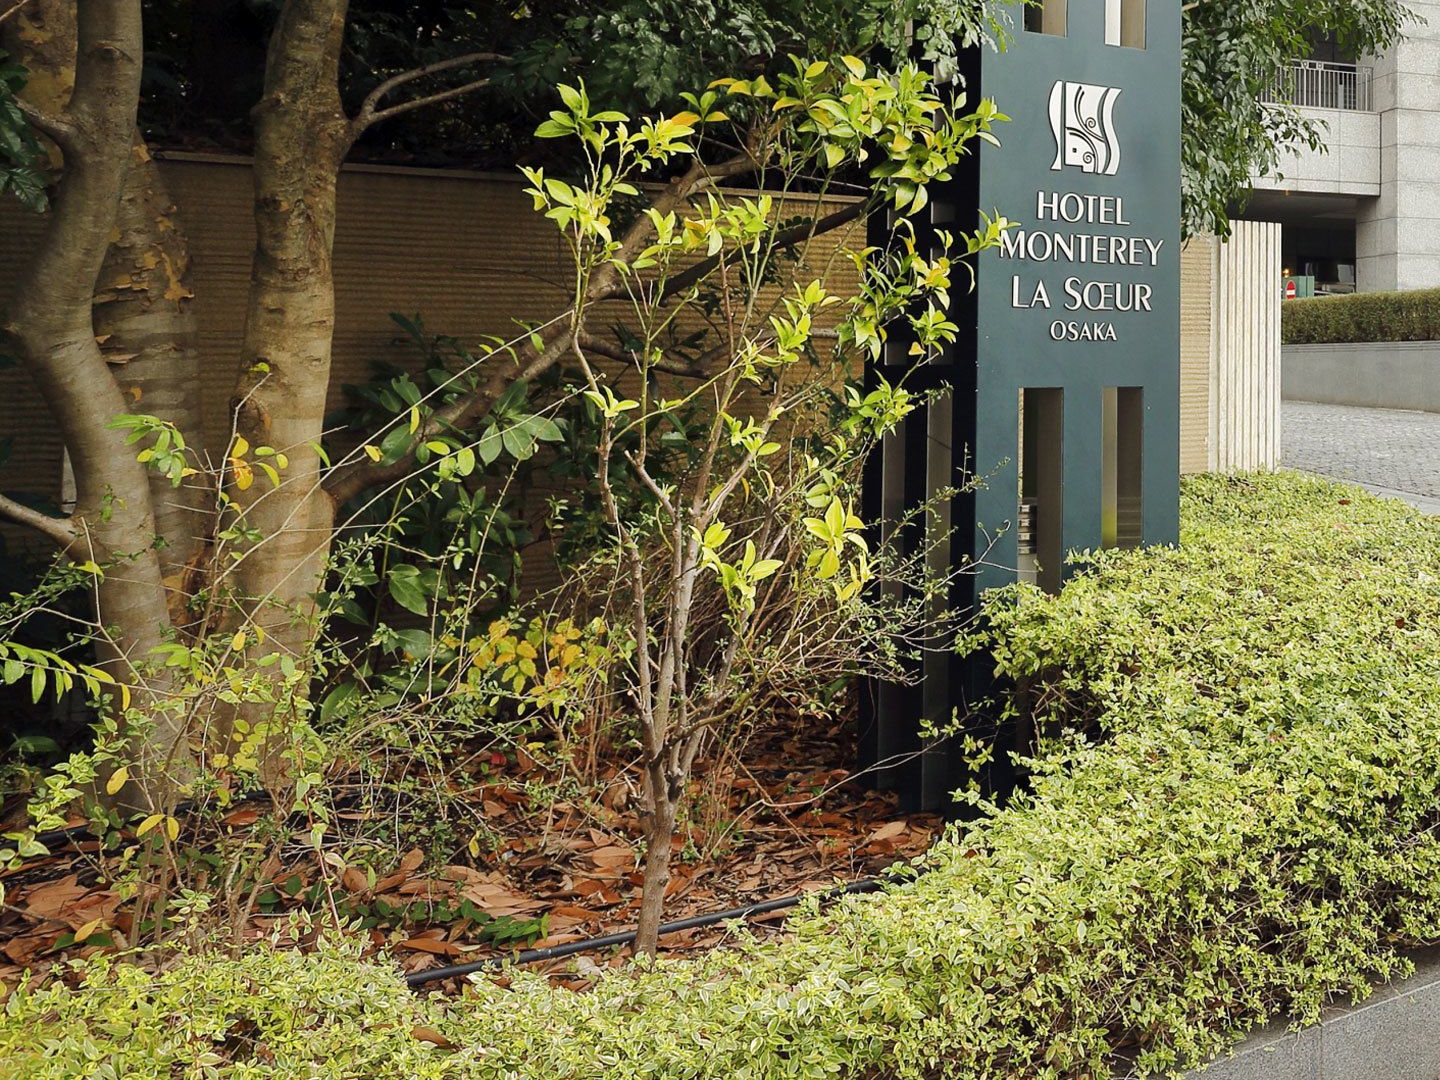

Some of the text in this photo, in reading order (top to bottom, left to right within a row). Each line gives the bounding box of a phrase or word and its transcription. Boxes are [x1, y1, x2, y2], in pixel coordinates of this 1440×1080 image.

[1037, 191, 1131, 225] HOTEL
[1000, 230, 1164, 266] MONTEREY
[1011, 275, 1152, 312] LA SŒUR
[1050, 320, 1117, 341] OSAKA
